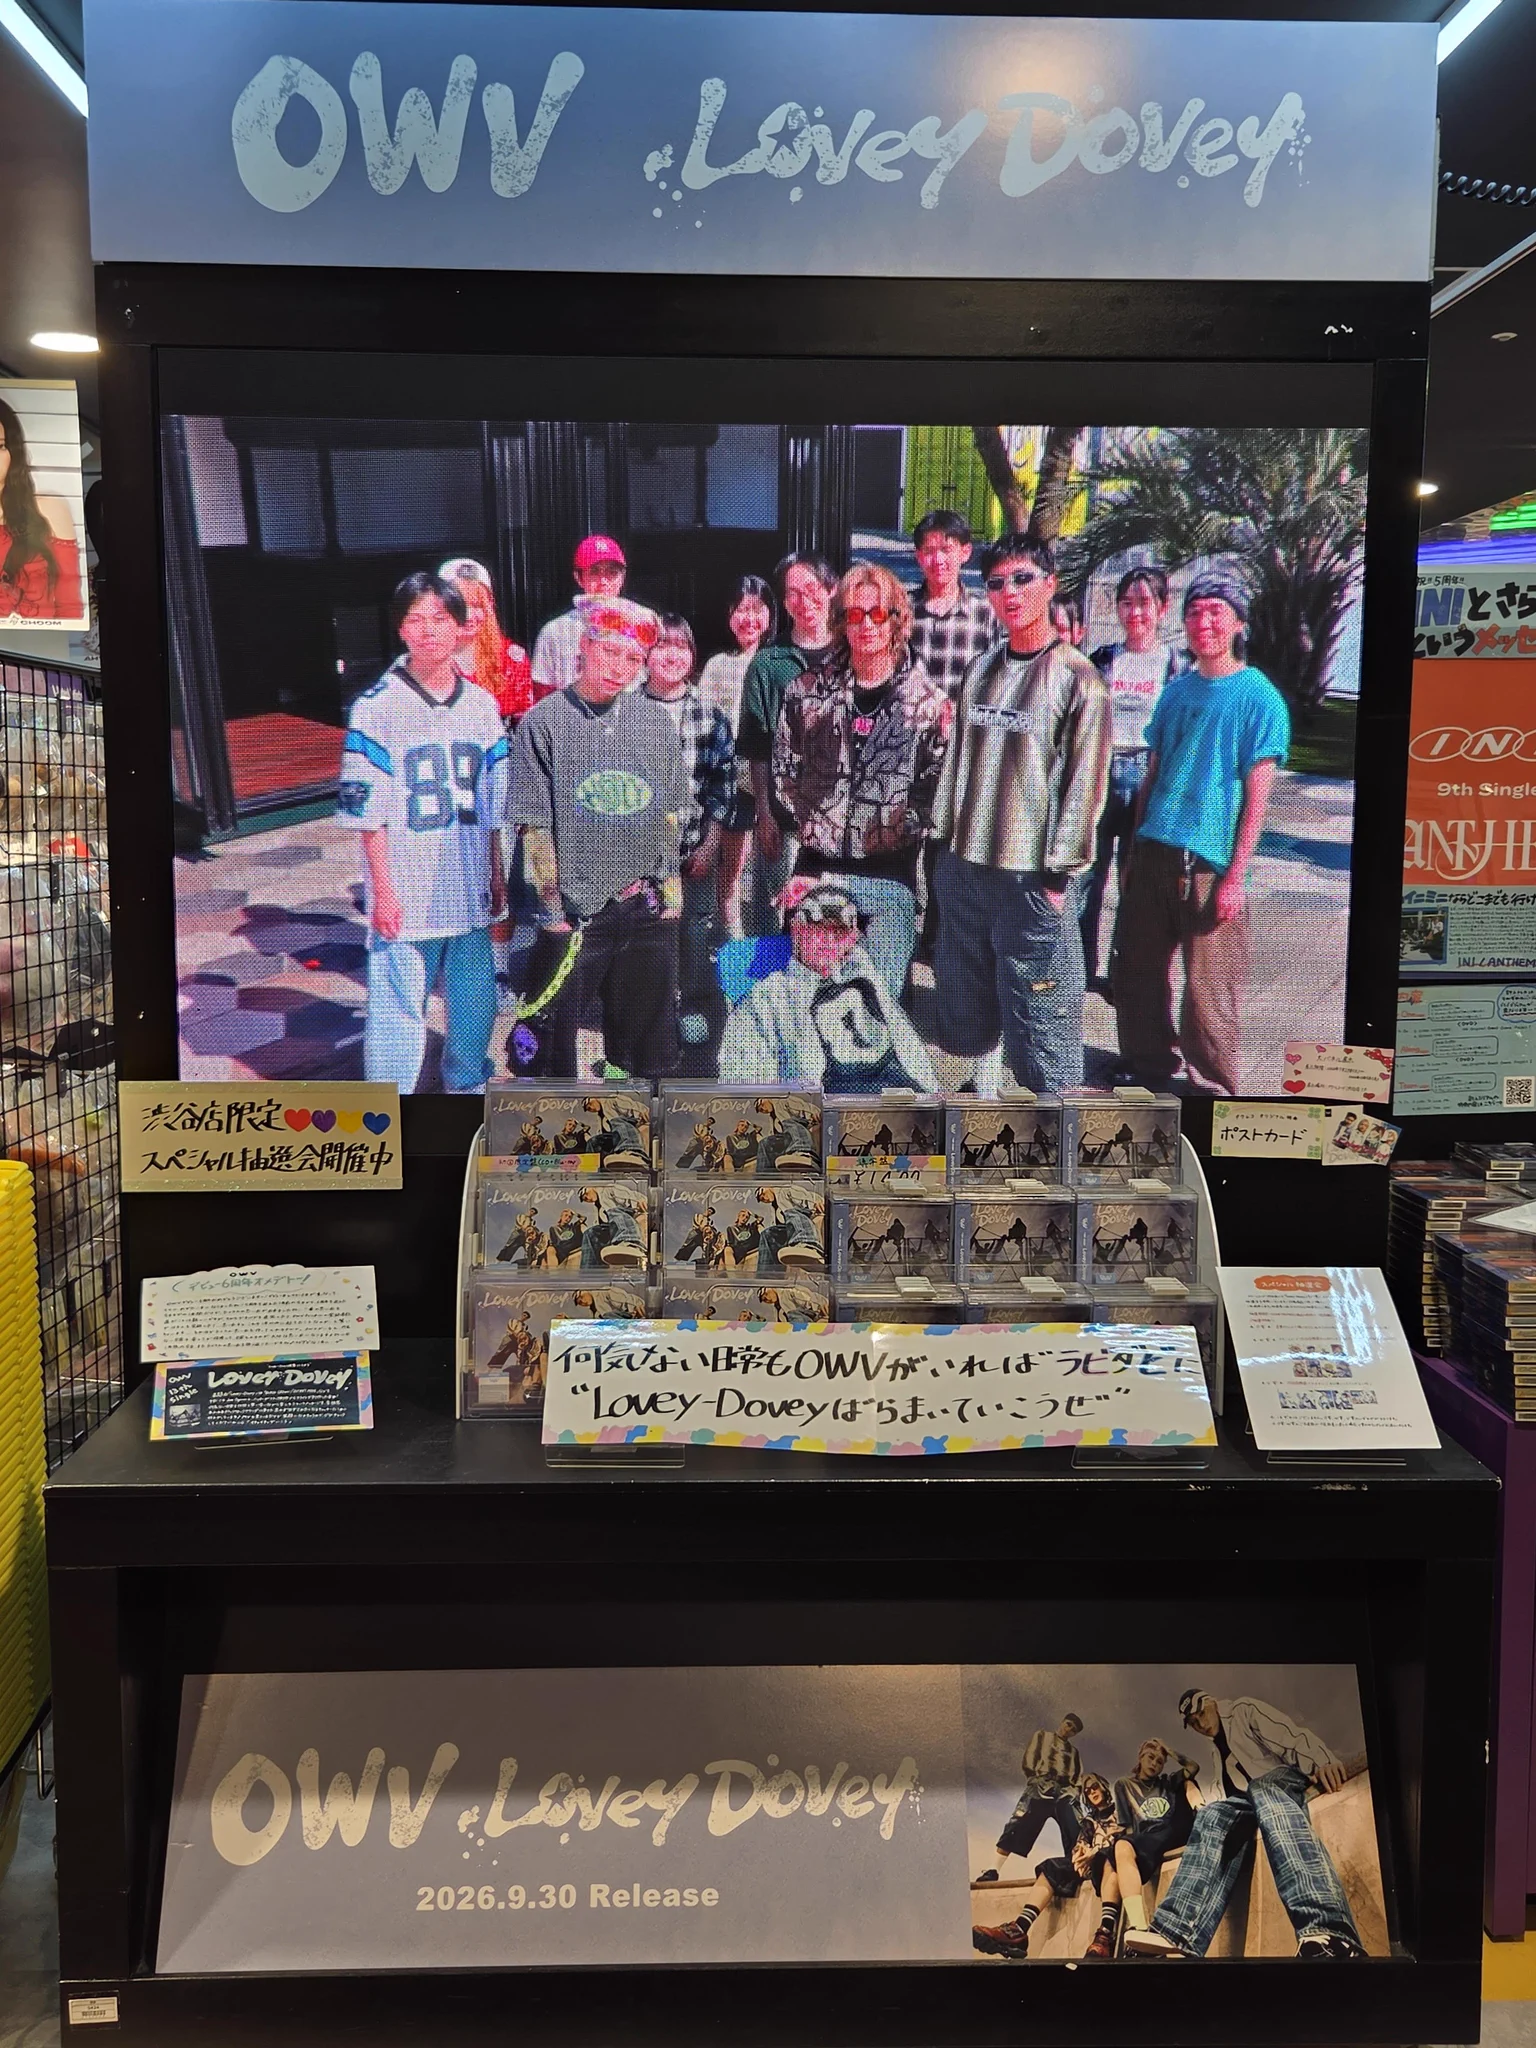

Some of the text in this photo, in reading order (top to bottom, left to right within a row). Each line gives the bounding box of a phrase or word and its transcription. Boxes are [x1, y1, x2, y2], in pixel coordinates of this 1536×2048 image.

[231, 51, 1308, 213] OWV Lovey Dovey
[1430, 733, 1536, 756] IN
[1437, 782, 1473, 797] 9th
[141, 1098, 287, 1134] 渋谷店限定
[1220, 1126, 1308, 1146] ポストカード
[140, 1142, 394, 1176] スペシャル抽選会開催中
[211, 1743, 920, 1866] OWV Lovey Dovey
[416, 1883, 720, 1912] 2026.9.30 Release
